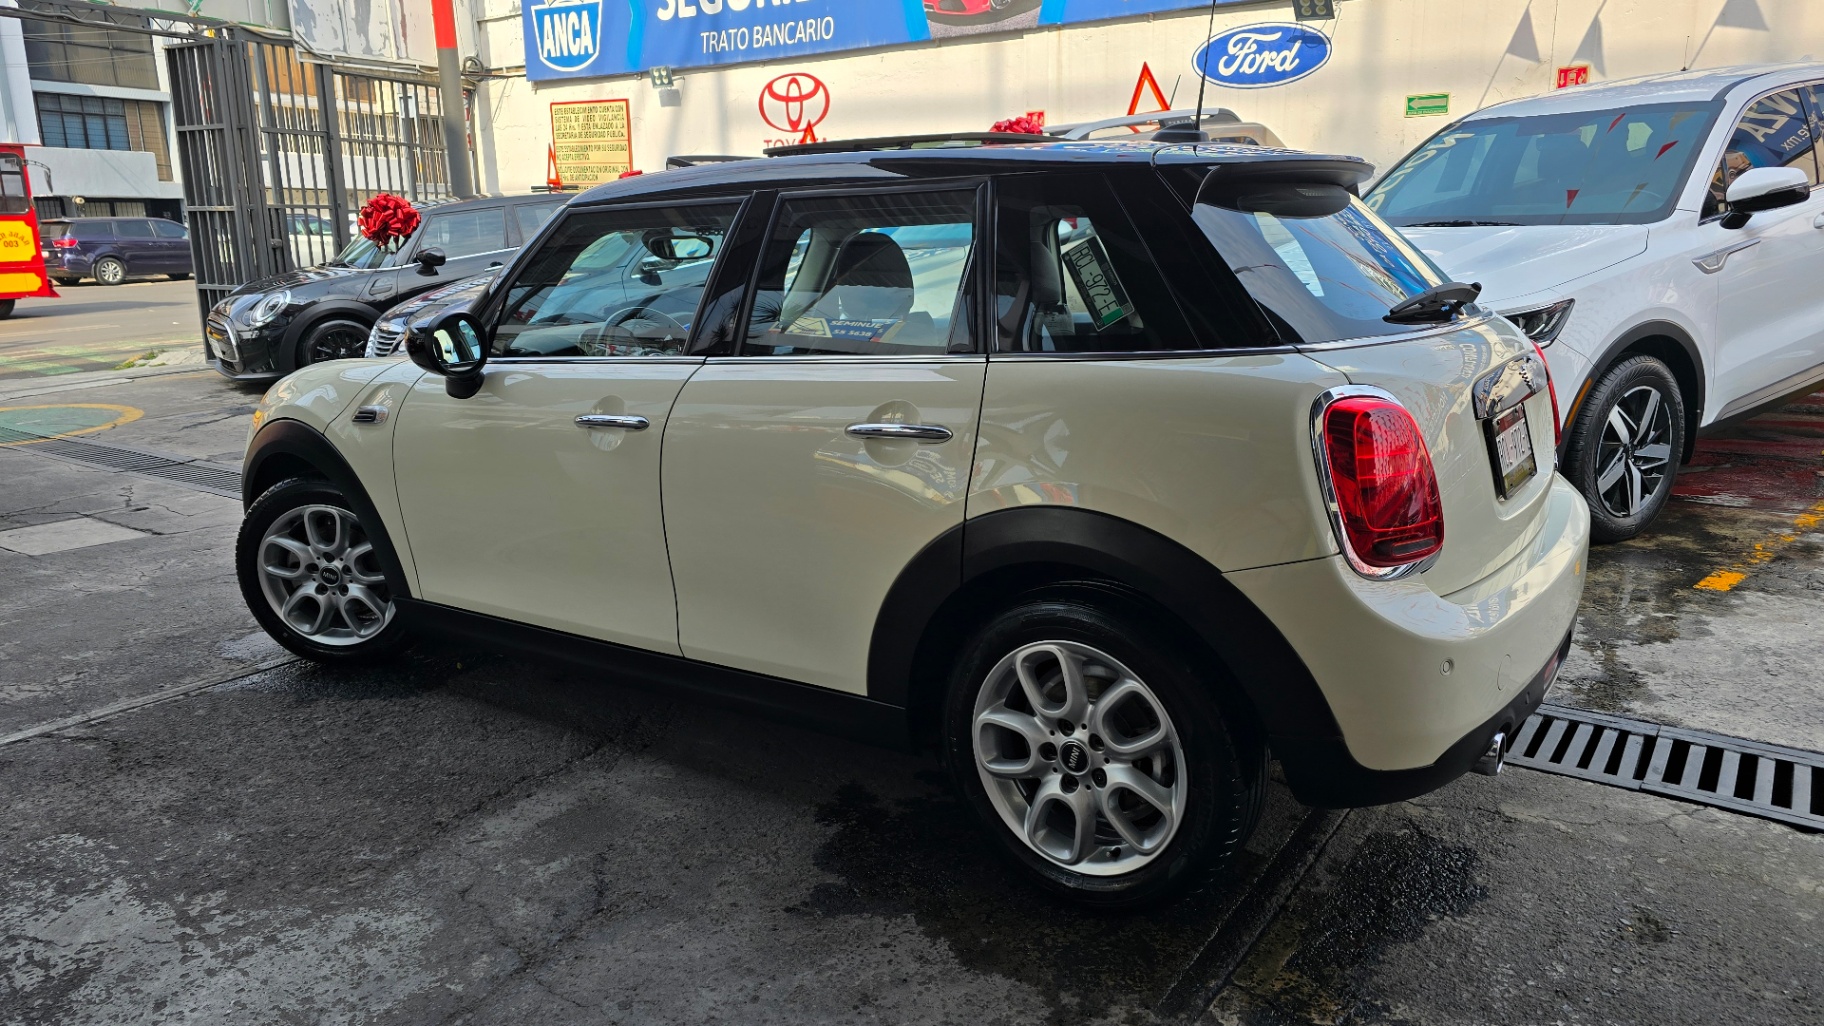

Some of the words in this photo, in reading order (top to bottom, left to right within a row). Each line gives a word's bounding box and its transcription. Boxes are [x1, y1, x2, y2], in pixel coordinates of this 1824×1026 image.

[543, 10, 594, 58] ANCA
[701, 27, 749, 54] TRATO
[753, 16, 834, 48] BANCARIO
[1218, 31, 1302, 76] Ford
[563, 105, 598, 115] ESTABLECIMENTO
[3, 240, 19, 248] 003
[1071, 246, 1119, 317] RCL-972-E
[1068, 746, 1080, 769] MINI
